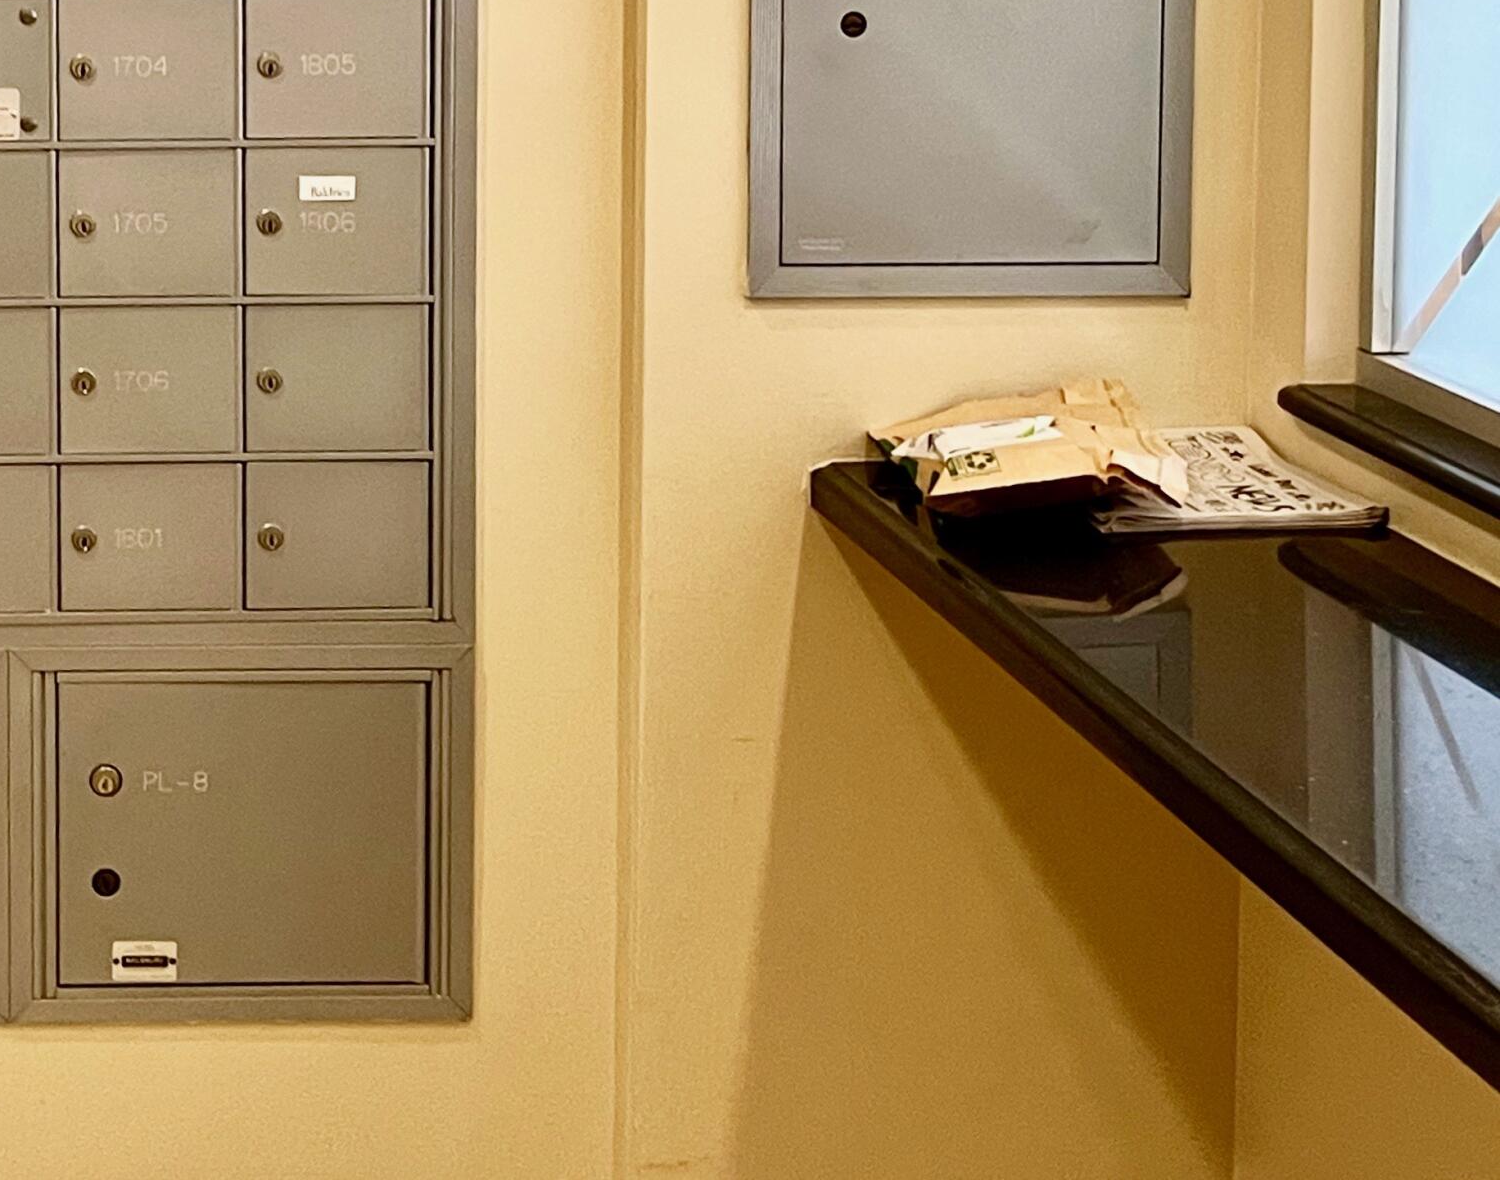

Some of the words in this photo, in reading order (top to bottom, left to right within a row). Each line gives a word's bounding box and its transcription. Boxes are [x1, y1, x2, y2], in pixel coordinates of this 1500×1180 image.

[113, 55, 168, 78] 1704
[300, 54, 357, 77] 1805
[113, 213, 169, 235] 1705
[113, 371, 170, 393] 1706
[141, 770, 209, 795] PL-8
